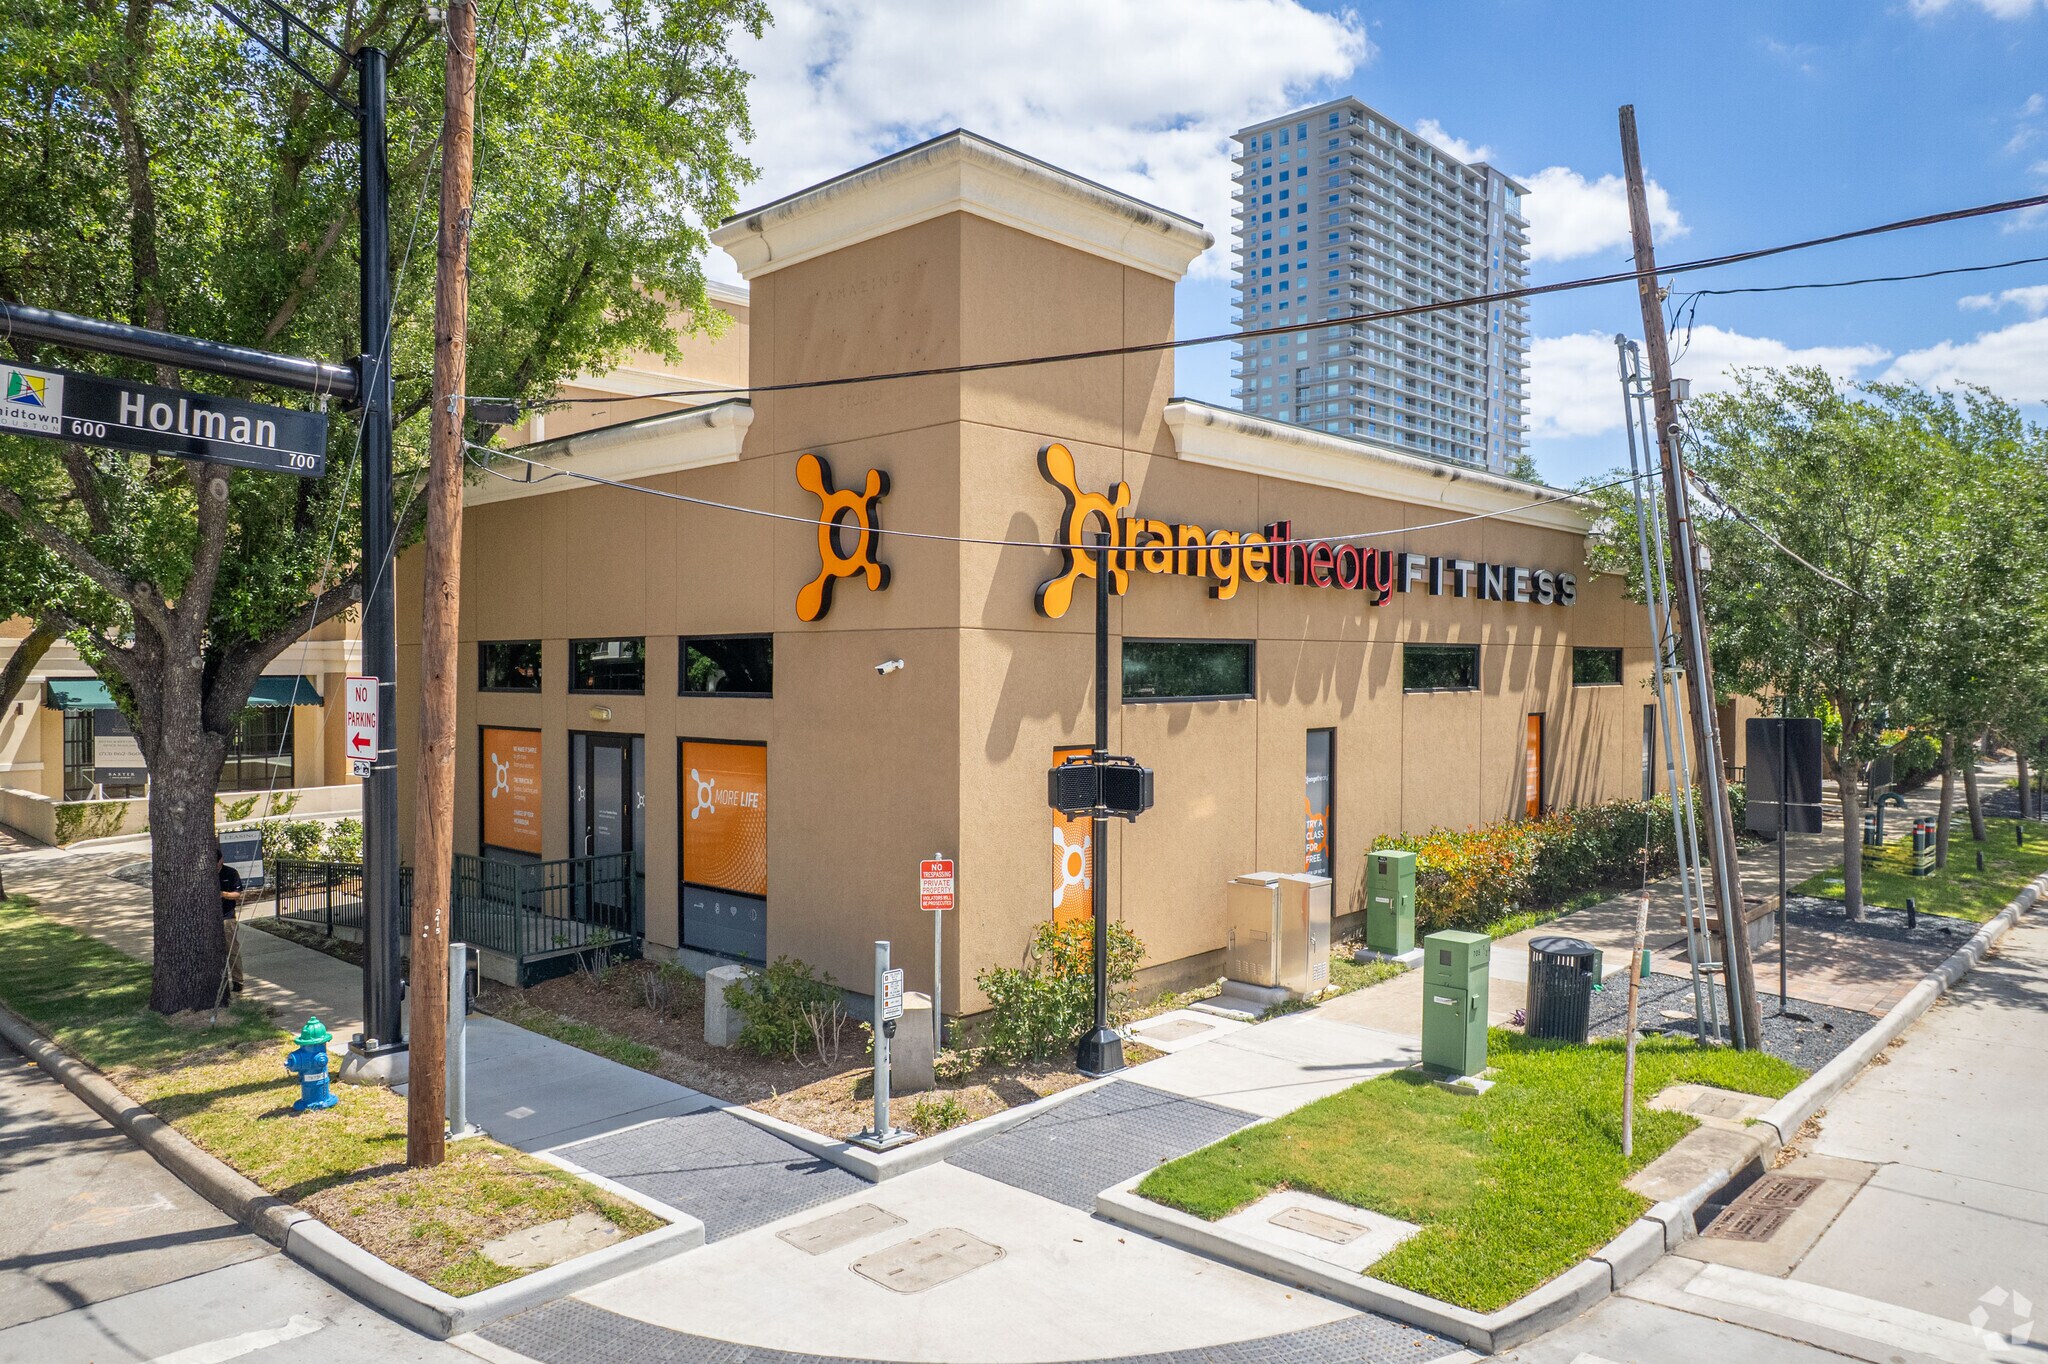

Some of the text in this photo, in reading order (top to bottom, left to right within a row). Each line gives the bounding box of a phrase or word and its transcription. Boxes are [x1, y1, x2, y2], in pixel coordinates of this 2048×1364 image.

[119, 390, 276, 448] Holman
[72, 420, 106, 438] 600
[288, 453, 315, 469] 700
[1397, 551, 1577, 608] FITNESS
[355, 687, 368, 702] NO
[348, 712, 375, 728] PARKING
[715, 789, 759, 808] MORE LIFE
[1306, 820, 1318, 828] TRY
[1306, 830, 1324, 840] CLASS
[1306, 843, 1318, 852] FOR
